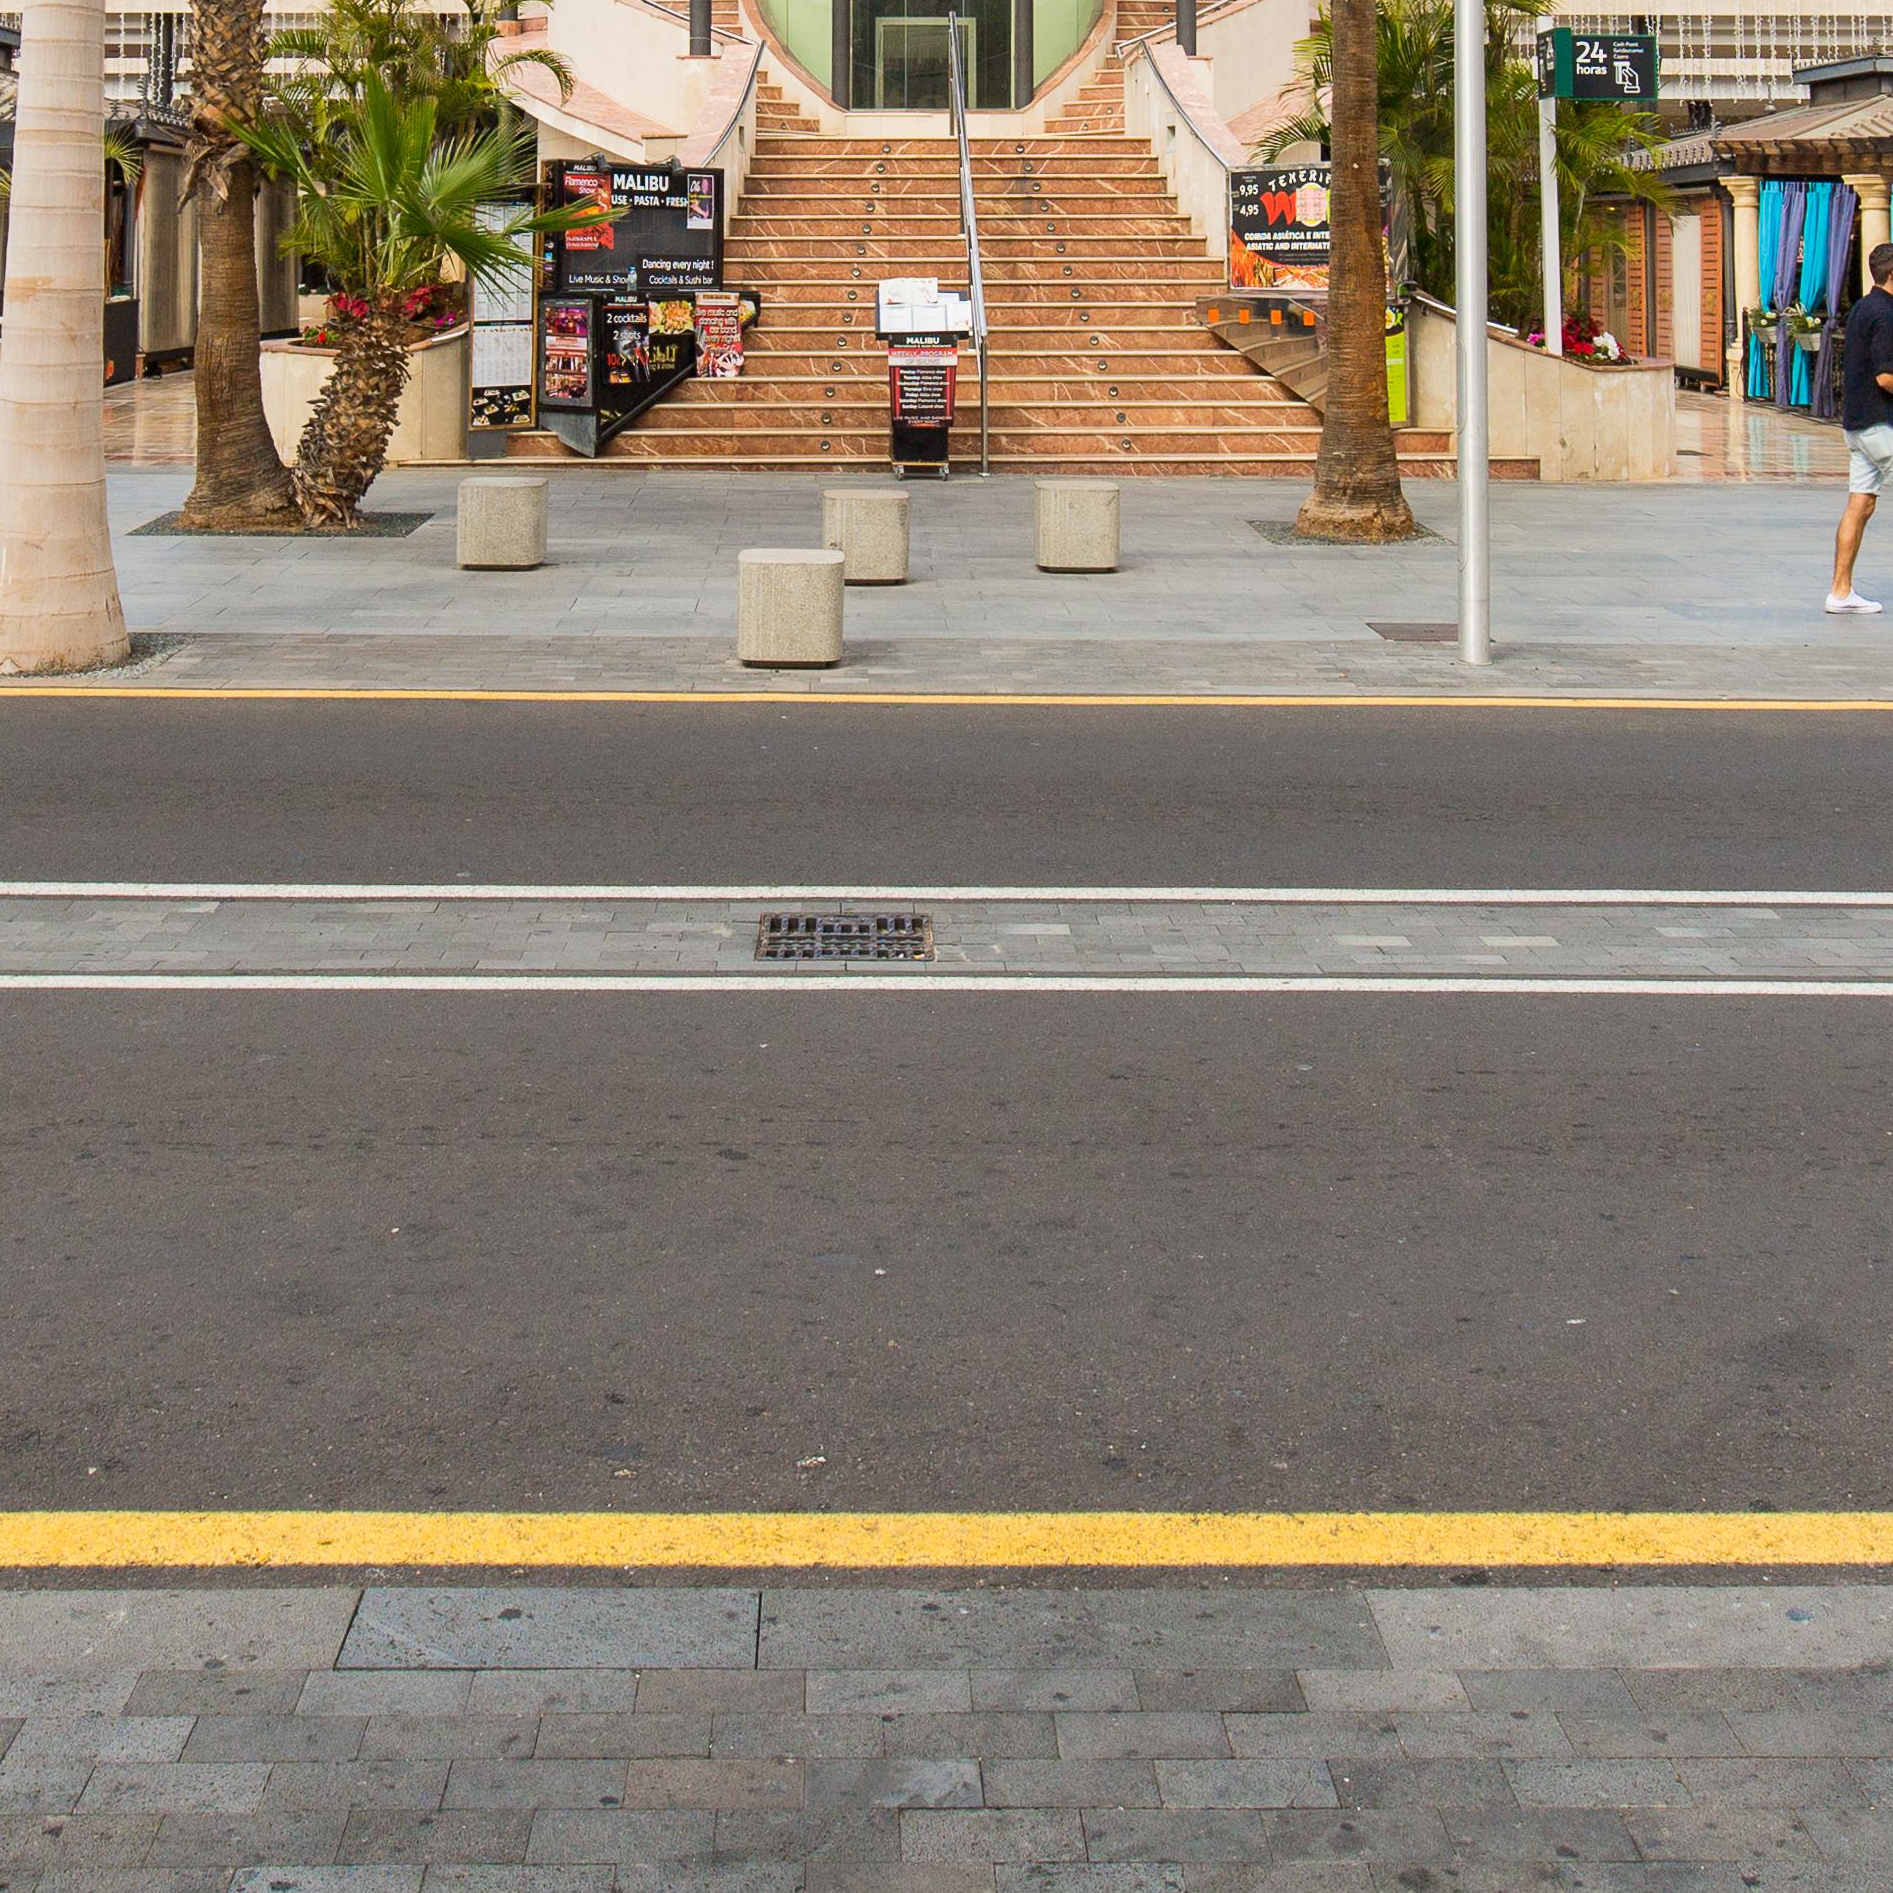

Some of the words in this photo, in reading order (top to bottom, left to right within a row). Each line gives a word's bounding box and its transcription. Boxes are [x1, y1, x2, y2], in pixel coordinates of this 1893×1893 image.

[1575, 41, 1608, 64] 24
[1576, 64, 1608, 75] horas
[565, 176, 599, 187] Flamenco
[613, 173, 669, 192] MALIBU
[1239, 184, 1259, 196] 9,95
[634, 196, 660, 207] PASTA
[1239, 204, 1259, 217] 4,95
[642, 259, 671, 271] Dancing
[672, 261, 692, 271] every
[692, 259, 711, 271] night
[569, 274, 583, 284] Live
[584, 274, 603, 284] Music
[606, 275, 611, 284] &
[649, 275, 678, 285] Cocktails
[679, 275, 684, 284] &
[684, 274, 702, 284] Sushi
[702, 274, 714, 285] bar
[607, 313, 612, 323] 2
[613, 313, 648, 323] cocktails
[613, 331, 618, 340] 2
[906, 336, 940, 344] MALIBU
